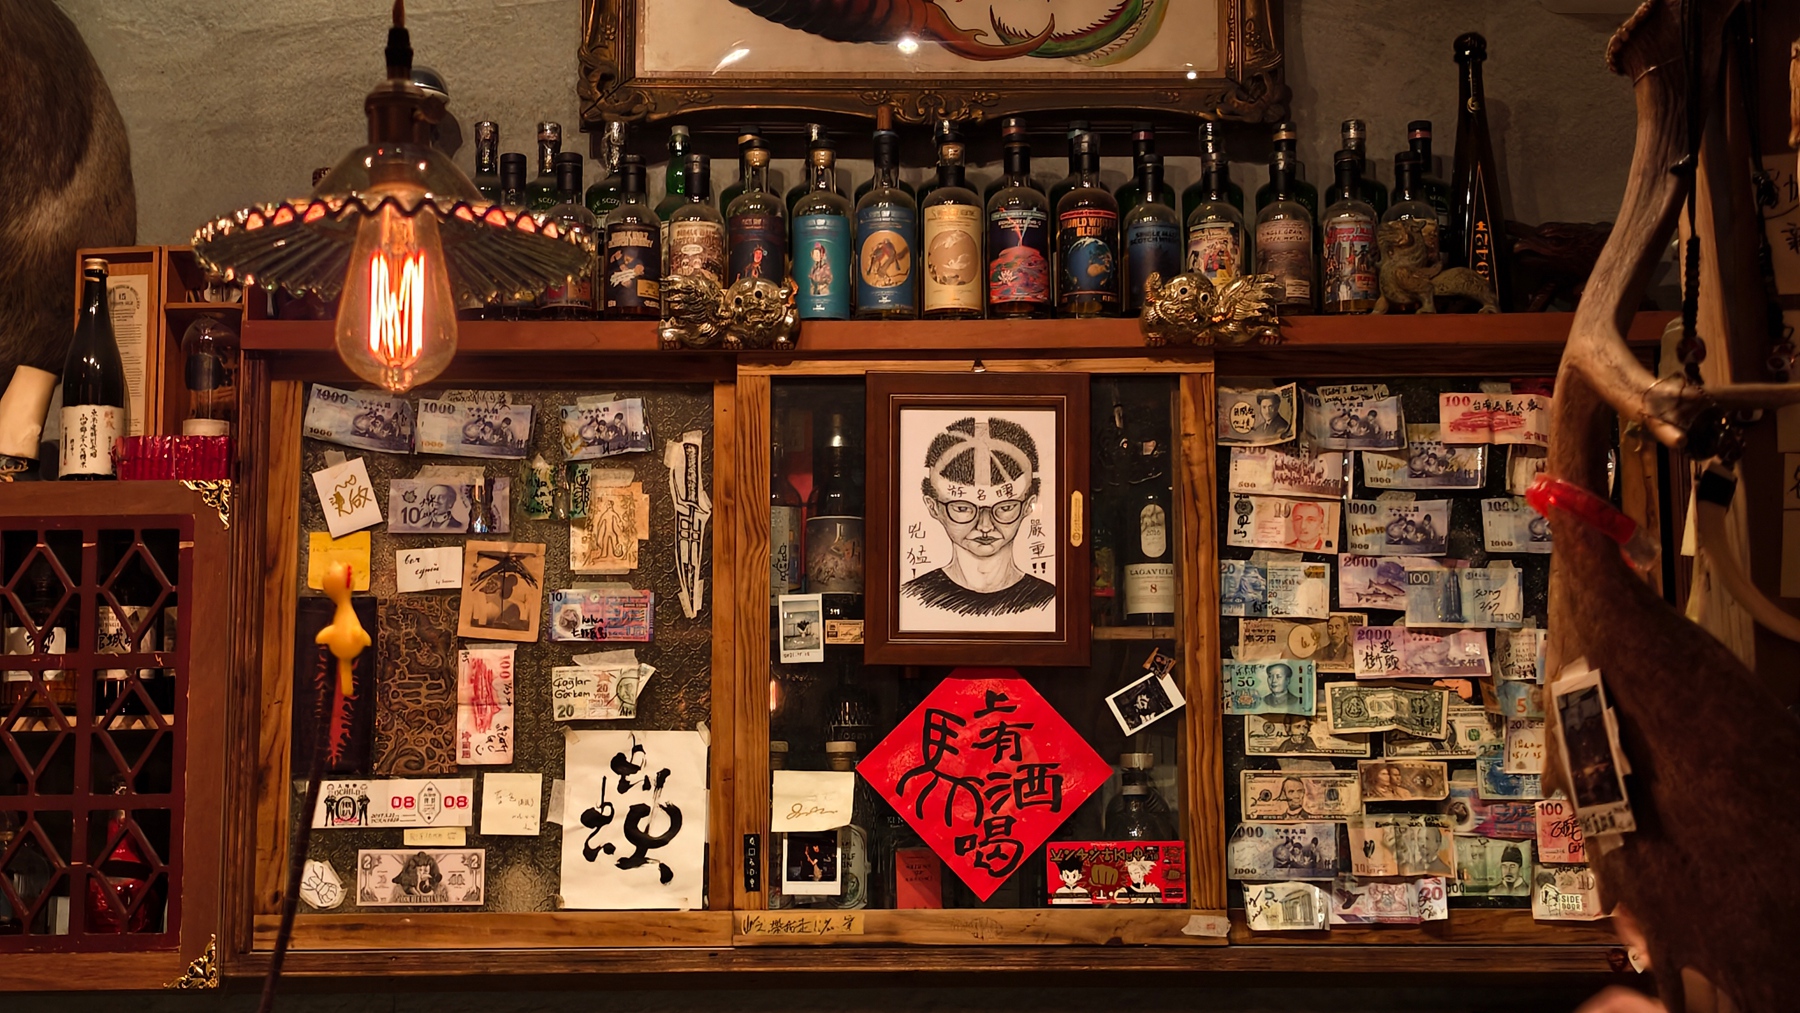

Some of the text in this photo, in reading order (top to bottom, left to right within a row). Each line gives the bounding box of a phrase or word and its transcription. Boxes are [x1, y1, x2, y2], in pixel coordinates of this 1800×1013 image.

[1475, 233, 1489, 281] 942
[316, 388, 349, 404] 1000
[1445, 396, 1471, 407] 100
[423, 402, 456, 414] 1000
[309, 427, 333, 437] 1000
[401, 506, 420, 524] 10
[1274, 502, 1291, 518] 10
[1348, 503, 1377, 515] 1000
[1220, 563, 1235, 574] 20
[1343, 557, 1378, 568] 2000
[1409, 573, 1430, 584] 100
[1150, 584, 1157, 593] 8
[551, 593, 562, 602] 10
[1505, 612, 1520, 621] 100
[1357, 629, 1392, 641] 2000
[500, 655, 511, 679] 100
[596, 684, 608, 692] 20
[1237, 677, 1255, 687] 50
[557, 704, 574, 718] 20
[1517, 698, 1527, 713] 5
[897, 709, 984, 827] 馬
[391, 796, 415, 809] 08
[444, 796, 468, 809] 08
[1540, 803, 1563, 816] 100
[363, 854, 371, 868] 2
[471, 855, 480, 868] 2
[1265, 886, 1275, 900] 5
[1421, 887, 1443, 900] 20
[1562, 895, 1579, 903] SIDE
